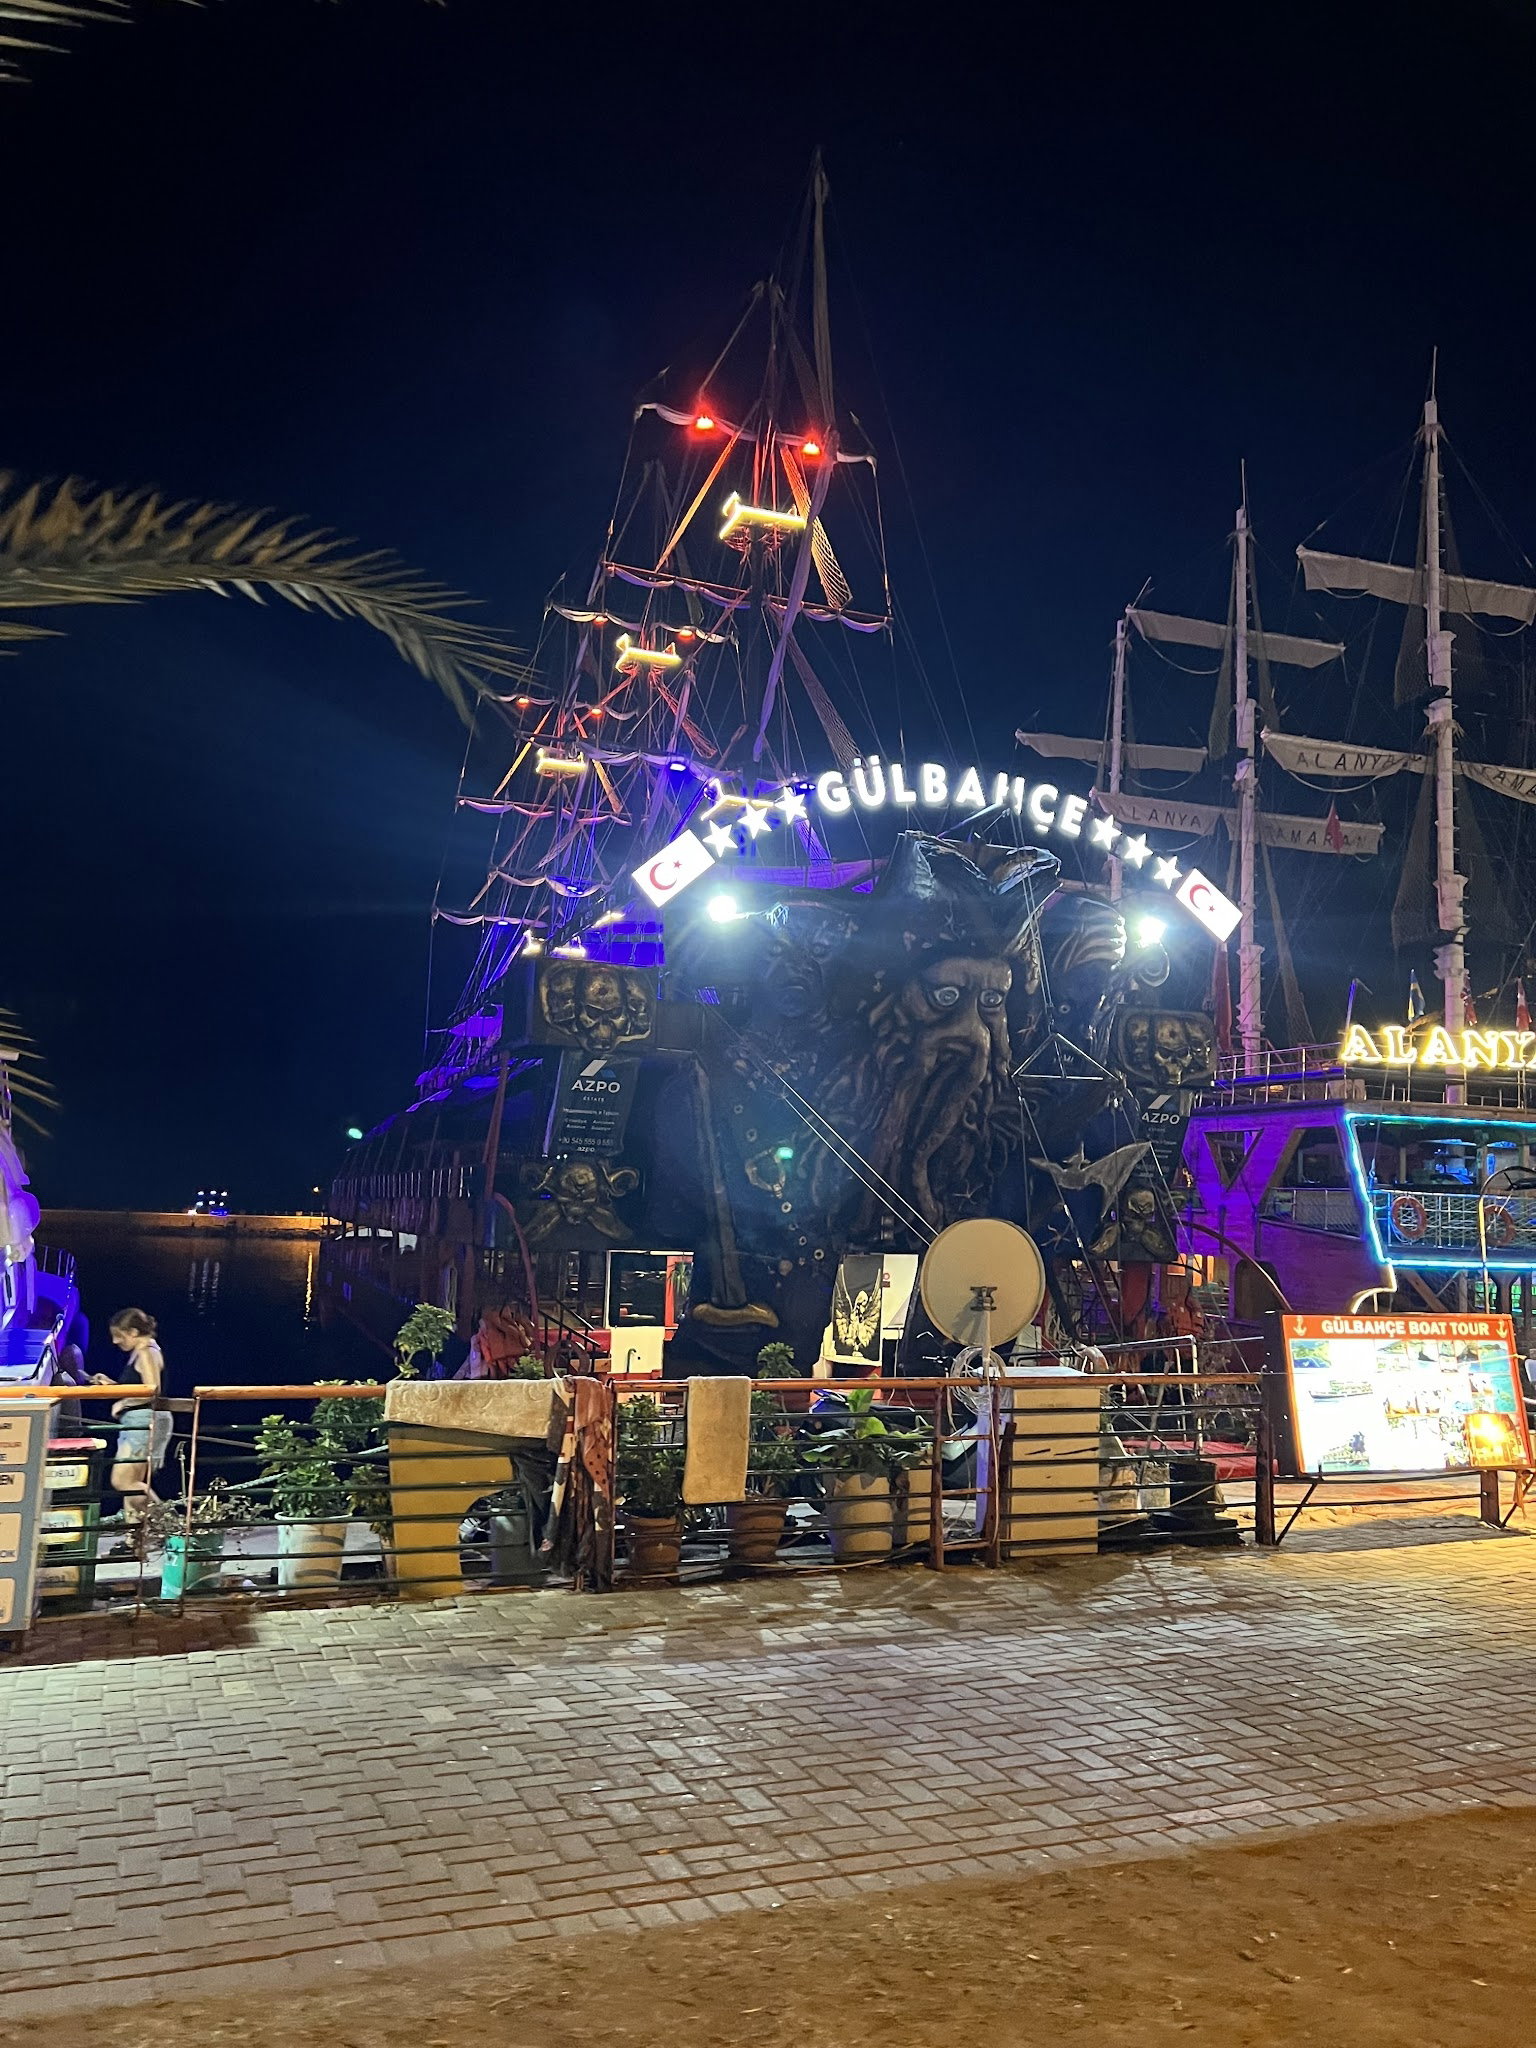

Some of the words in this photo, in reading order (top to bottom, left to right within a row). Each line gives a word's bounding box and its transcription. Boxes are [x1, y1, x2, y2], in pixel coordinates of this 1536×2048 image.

[817, 755, 1089, 837] GÜLBAHÇE
[1341, 1024, 1536, 1069] ALANY
[571, 1079, 621, 1094] AZPO
[1141, 1112, 1180, 1125] AZPO
[1321, 1317, 1406, 1338] GÜLBAHÇE
[1408, 1320, 1448, 1336] BOAT
[1449, 1321, 1490, 1336] TOUR
